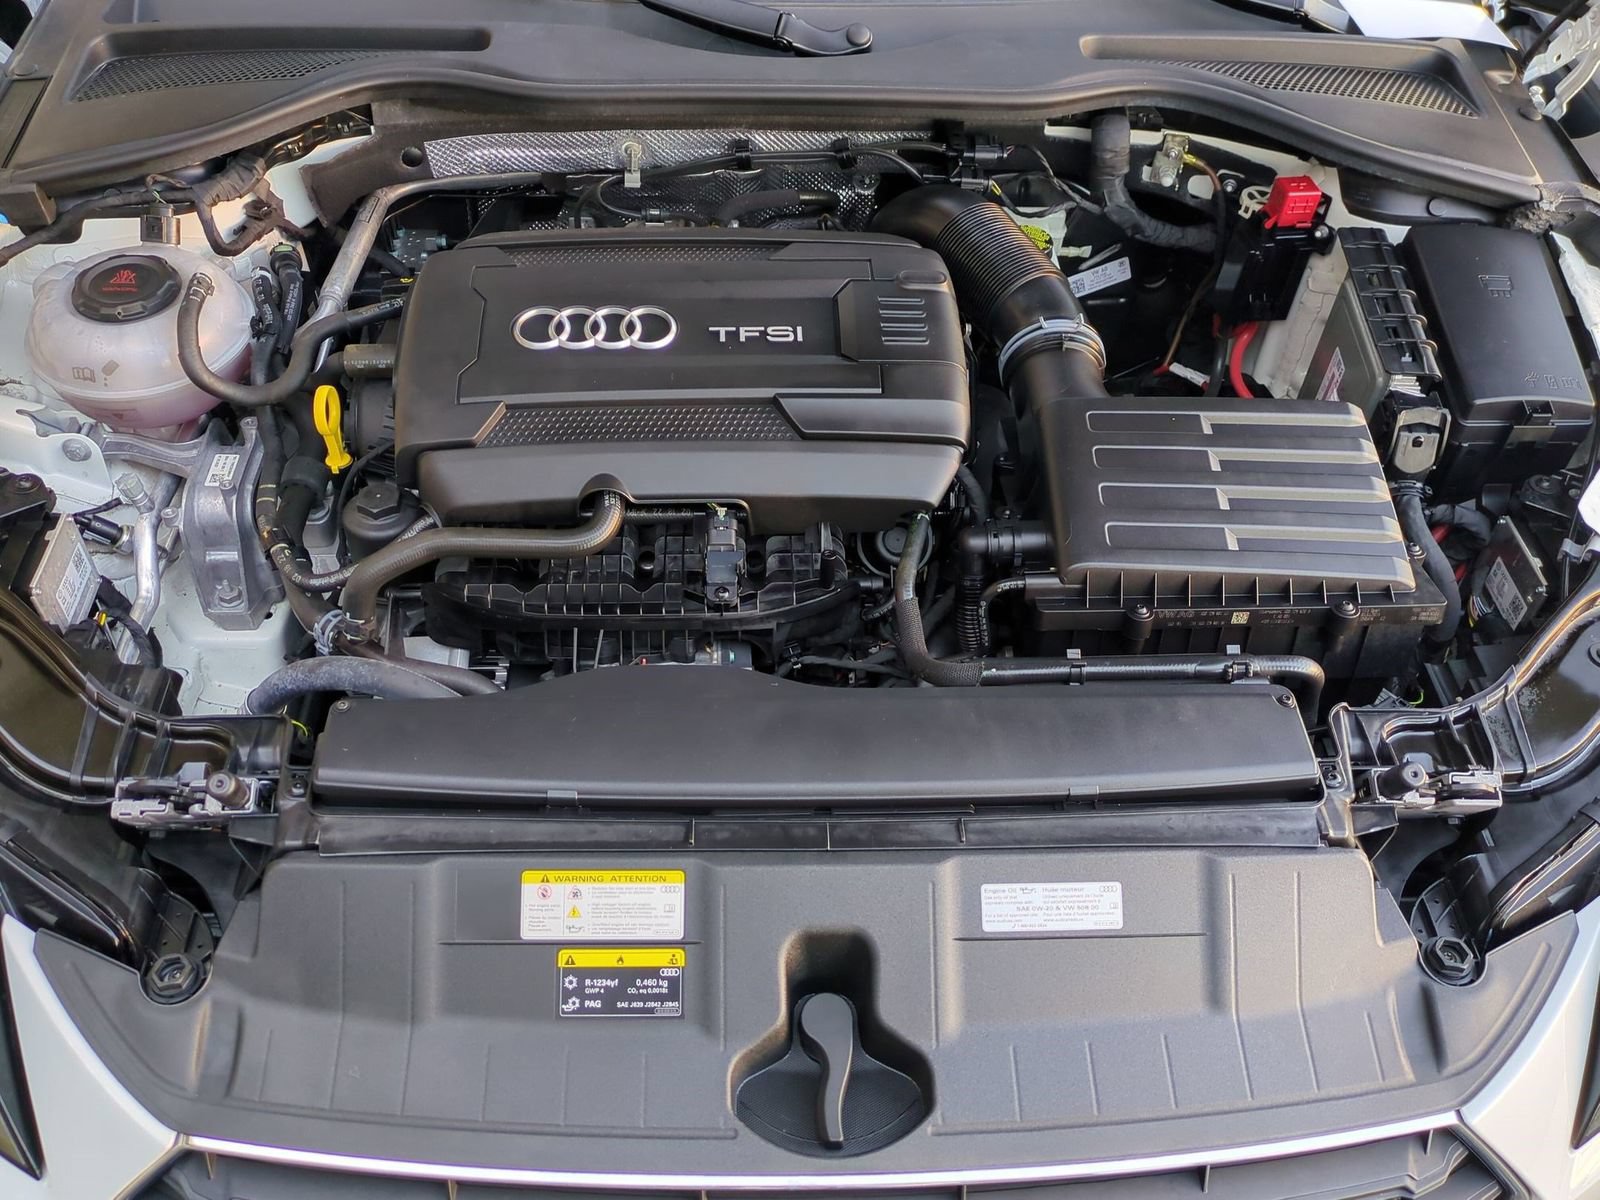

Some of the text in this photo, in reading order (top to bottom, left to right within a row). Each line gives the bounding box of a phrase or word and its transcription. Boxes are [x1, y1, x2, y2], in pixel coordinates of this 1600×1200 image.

[708, 324, 804, 343] TFSI
[553, 875, 604, 883] WARNING
[584, 978, 619, 988] R-1234yf
[659, 978, 669, 988] kg
[584, 1000, 602, 1008] PAG
